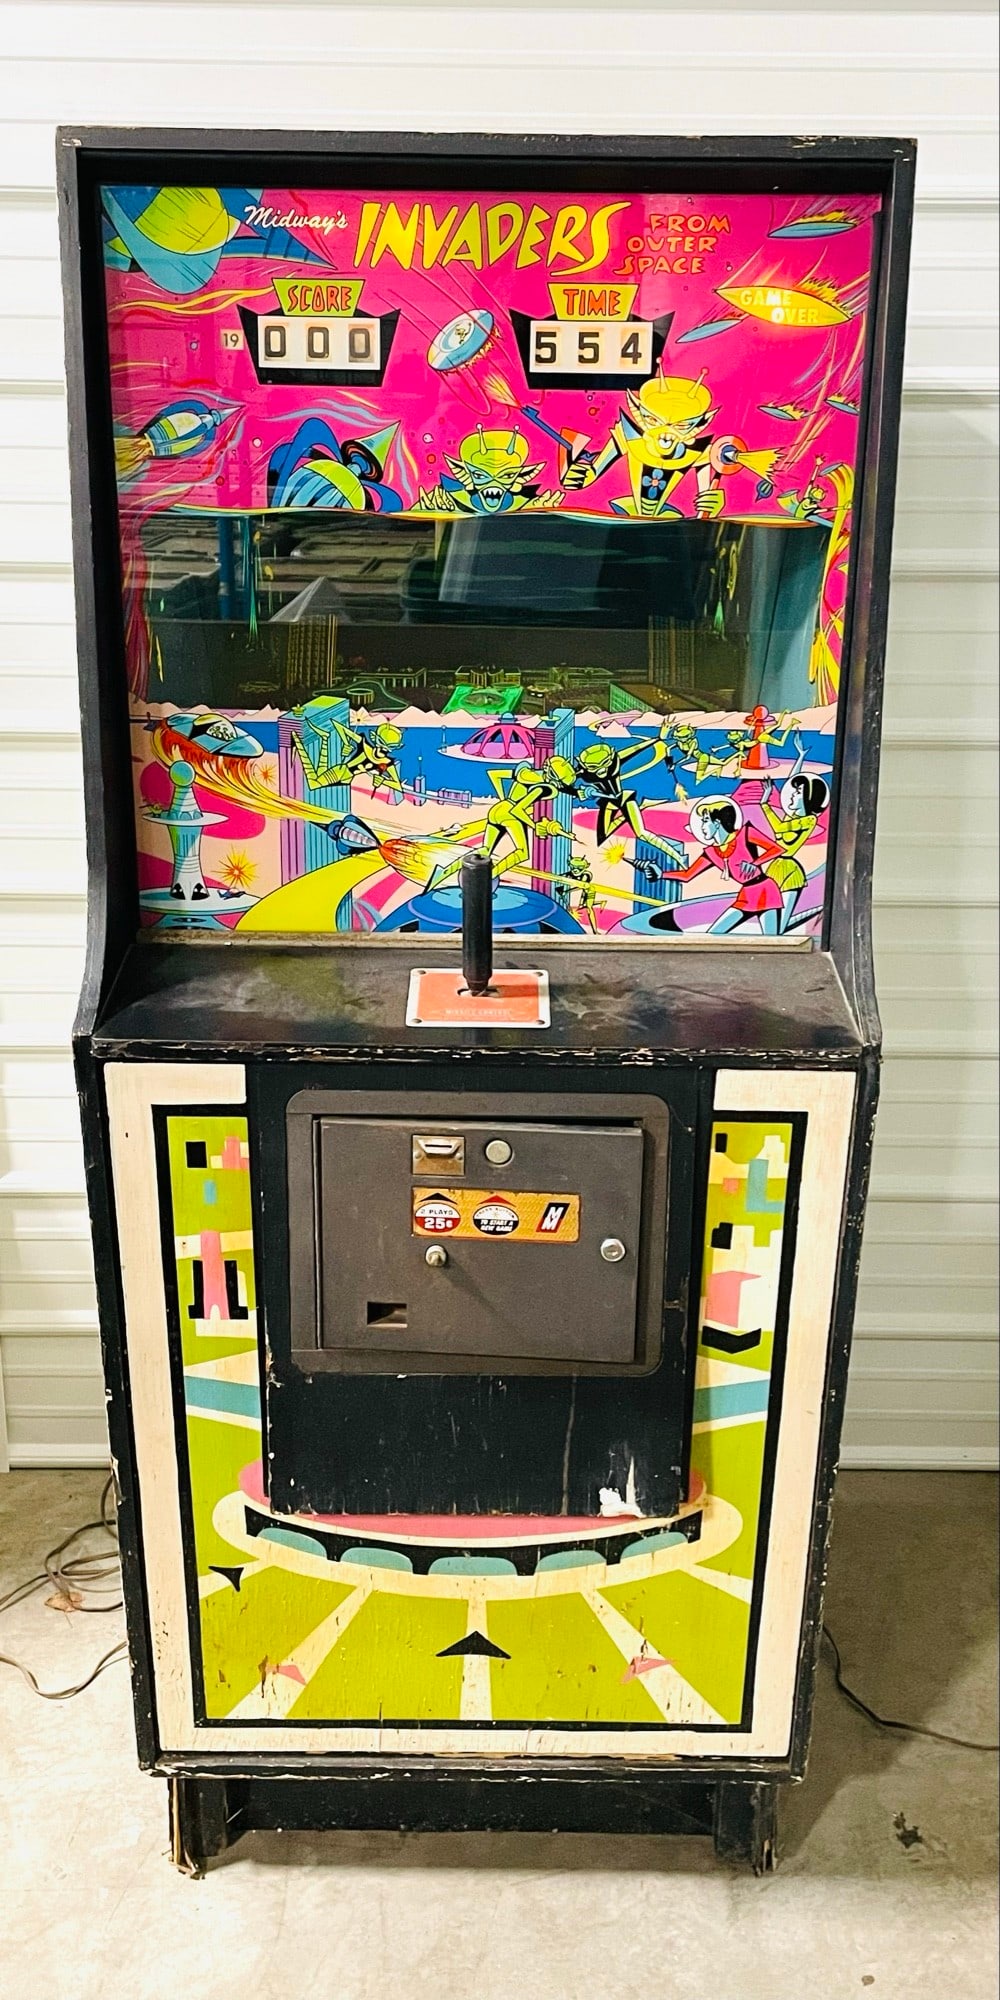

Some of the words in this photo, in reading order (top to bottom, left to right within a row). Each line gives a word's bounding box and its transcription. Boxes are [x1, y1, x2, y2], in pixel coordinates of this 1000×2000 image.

[244, 205, 348, 235] Midway's
[650, 214, 731, 233] FROM
[353, 201, 631, 277] INVADERS
[627, 236, 718, 252] OUTER
[613, 256, 706, 275] SPACE
[287, 285, 353, 312] SCORE
[563, 289, 621, 316] TIME
[740, 290, 792, 306] GAME
[771, 307, 819, 323] OVER
[223, 333, 240, 347] 19
